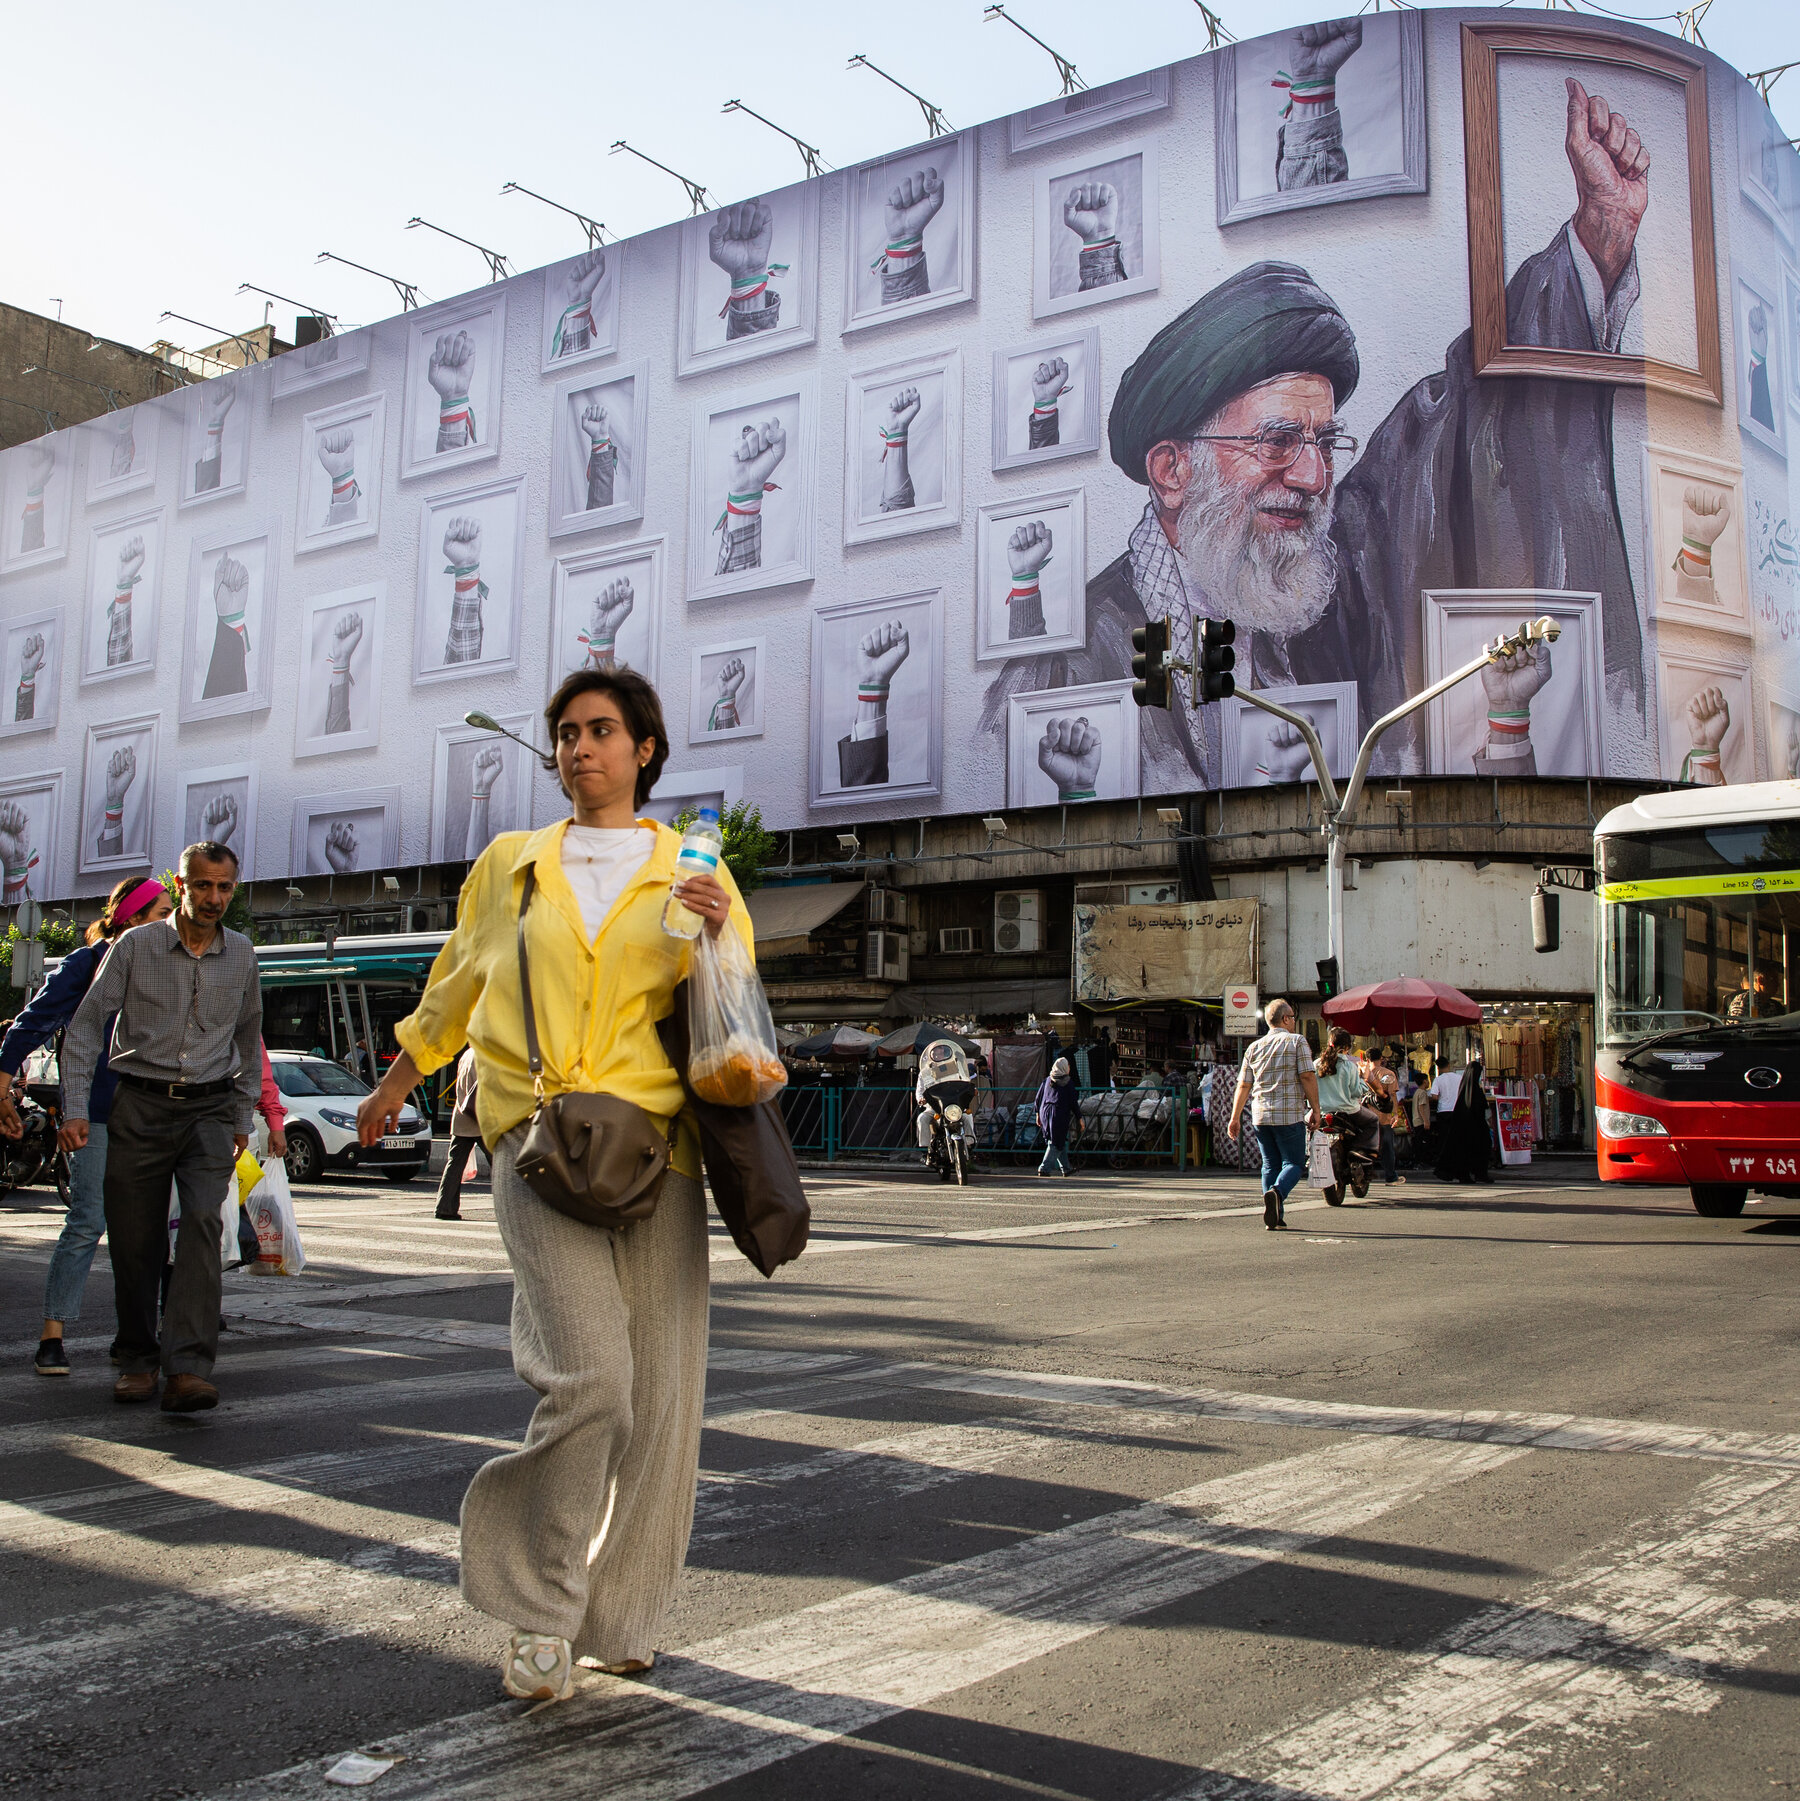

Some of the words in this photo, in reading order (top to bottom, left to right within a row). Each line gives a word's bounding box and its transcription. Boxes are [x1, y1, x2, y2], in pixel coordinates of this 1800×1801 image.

[1623, 884, 1638, 892] پارک
[1127, 916, 1146, 932] روشا
[1188, 919, 1194, 930] و
[1196, 913, 1213, 926] لاک
[1215, 913, 1243, 929] دنیای
[1730, 1157, 1755, 1174] ۳۳
[1766, 1158, 1797, 1175] ۹۵۹
